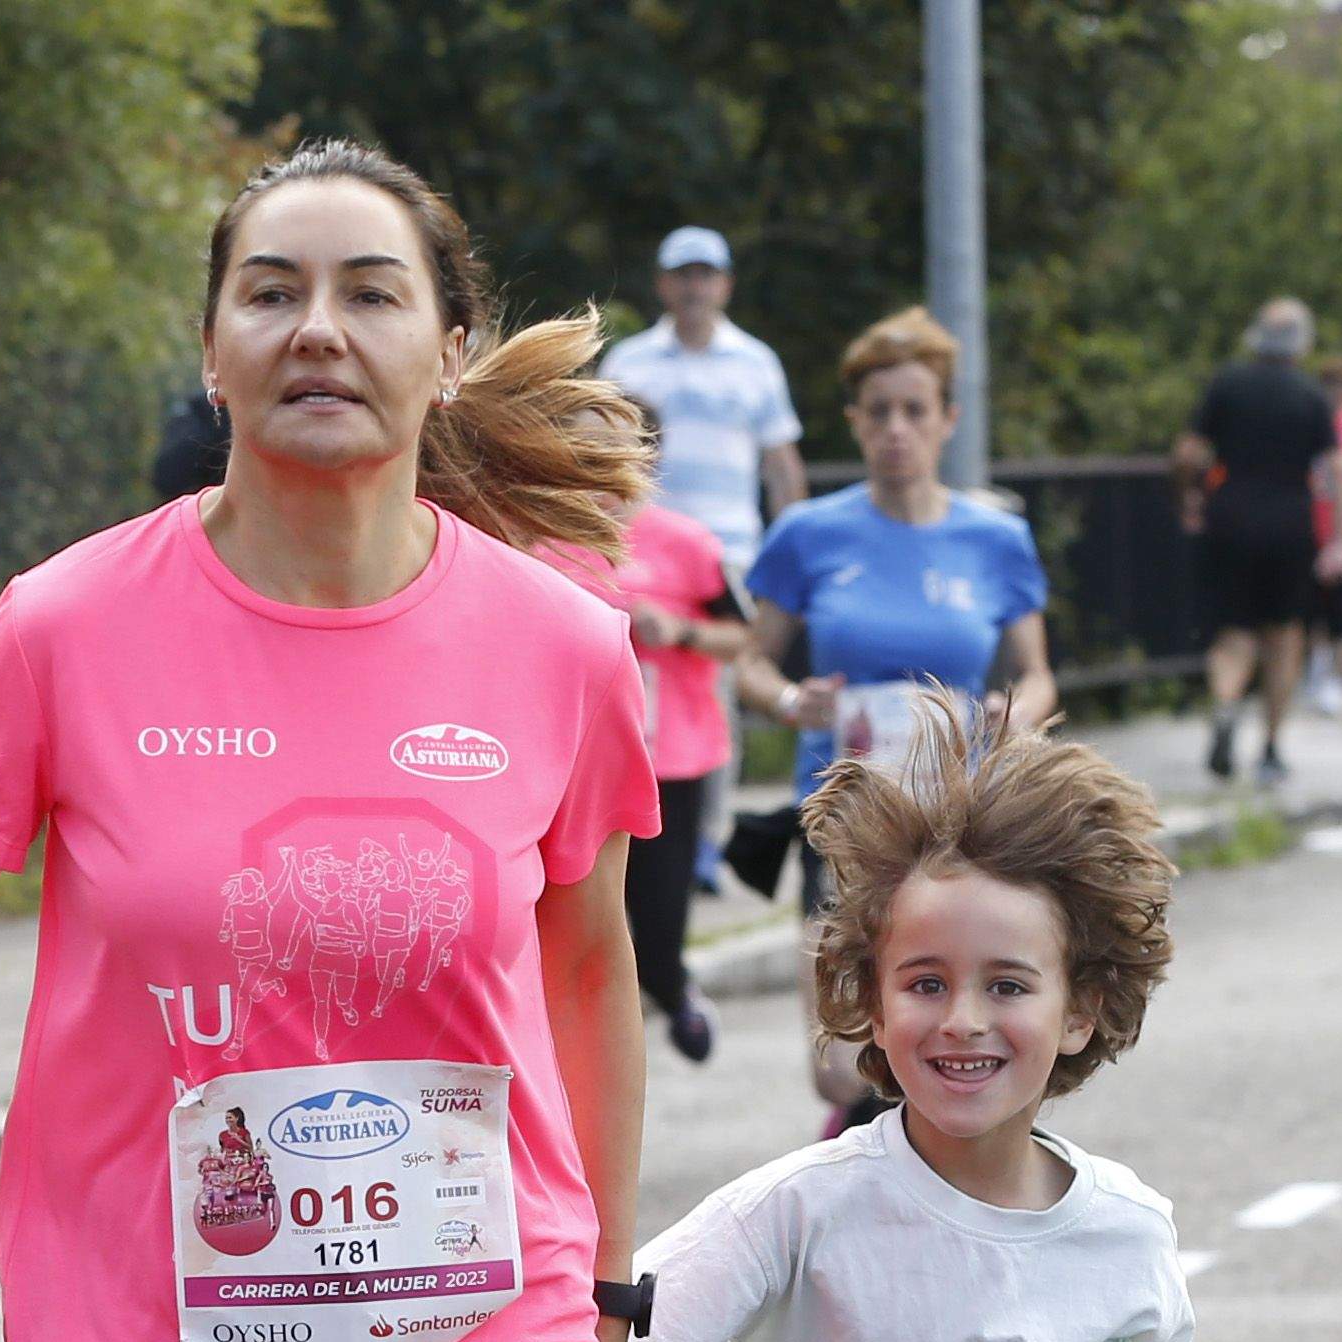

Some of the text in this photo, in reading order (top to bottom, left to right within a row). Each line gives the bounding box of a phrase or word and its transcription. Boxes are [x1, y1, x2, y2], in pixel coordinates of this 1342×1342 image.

[138, 727, 277, 758] OYSHO
[147, 983, 233, 1047] TU
[420, 1088, 484, 1098] TU DORSAL
[421, 1098, 483, 1114] SUMA
[290, 1181, 400, 1228] 016
[314, 1239, 379, 1267] 1781
[218, 1270, 488, 1299] CARRERA DE LA MUJER 2023
[398, 1310, 495, 1335] Santander
